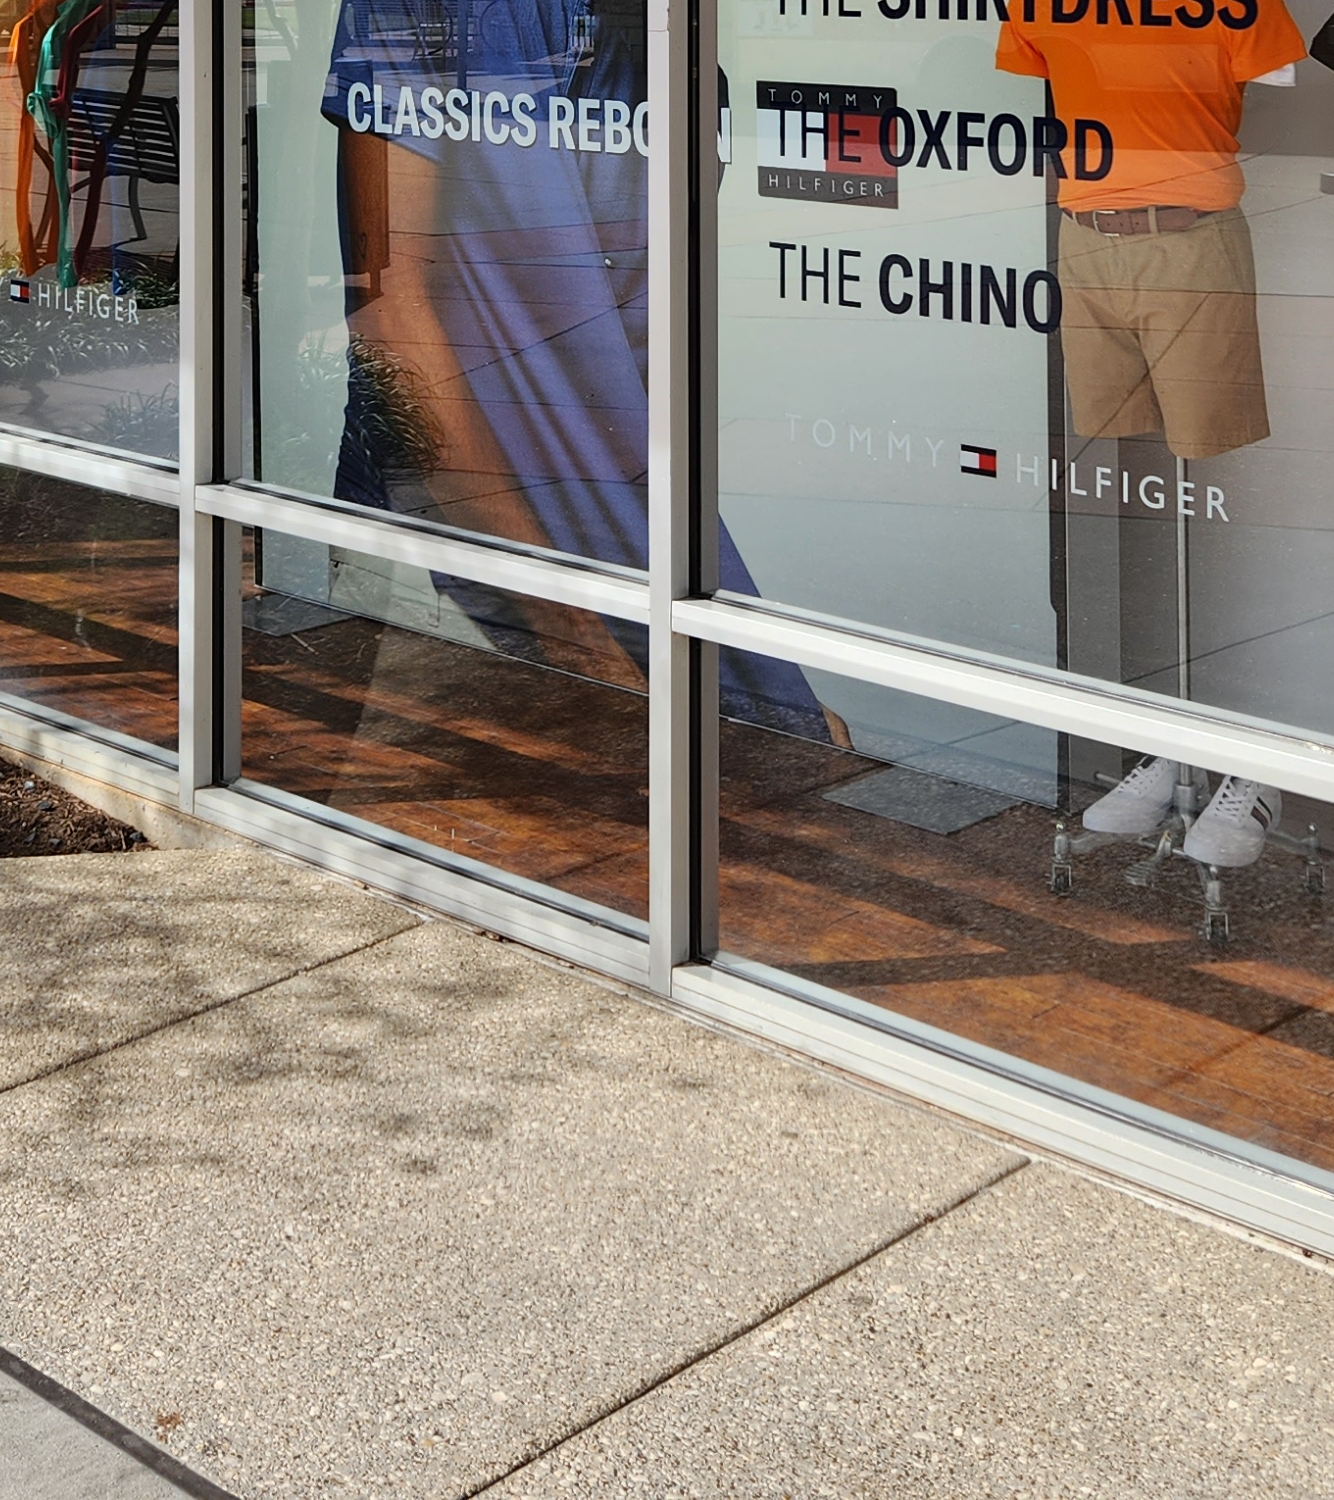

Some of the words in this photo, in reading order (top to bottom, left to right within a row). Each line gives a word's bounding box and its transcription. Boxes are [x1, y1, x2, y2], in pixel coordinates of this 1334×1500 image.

[347, 82, 537, 148] CLASSICS
[549, 95, 731, 163] REBON
[768, 88, 882, 109] TOMMY
[769, 101, 862, 163] THE
[879, 106, 1113, 181] OXFORD
[768, 174, 884, 197] HILFIGER
[38, 283, 140, 325] HILFIGER
[769, 241, 862, 309] THE
[878, 254, 1063, 335] CHINO
[784, 412, 944, 468] TOMMY
[1015, 453, 1230, 523] HILFIGER
